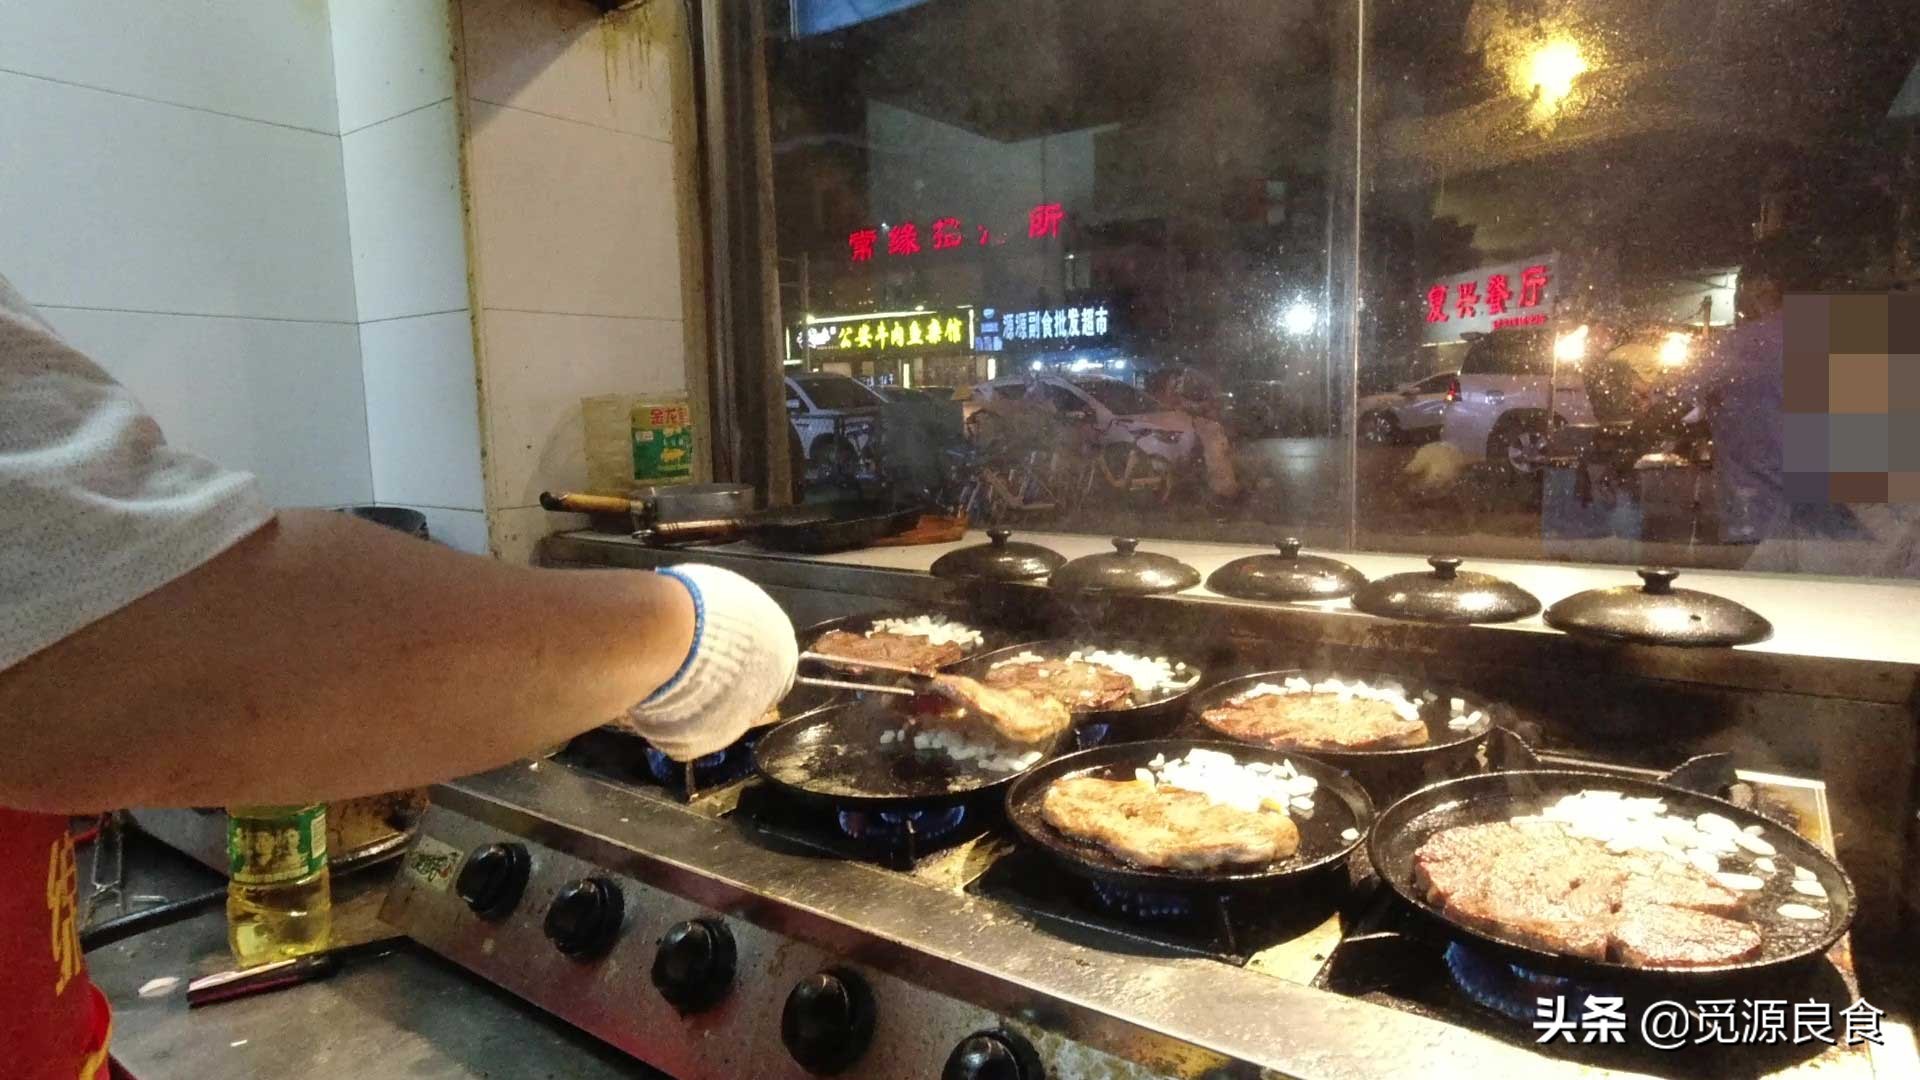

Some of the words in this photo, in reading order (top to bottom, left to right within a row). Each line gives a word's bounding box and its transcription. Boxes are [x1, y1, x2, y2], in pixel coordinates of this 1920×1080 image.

[848, 202, 1066, 262] 常缘招所
[1002, 305, 1109, 340] 源源副食批发超市
[1426, 265, 1551, 324] 复兴餐厅
